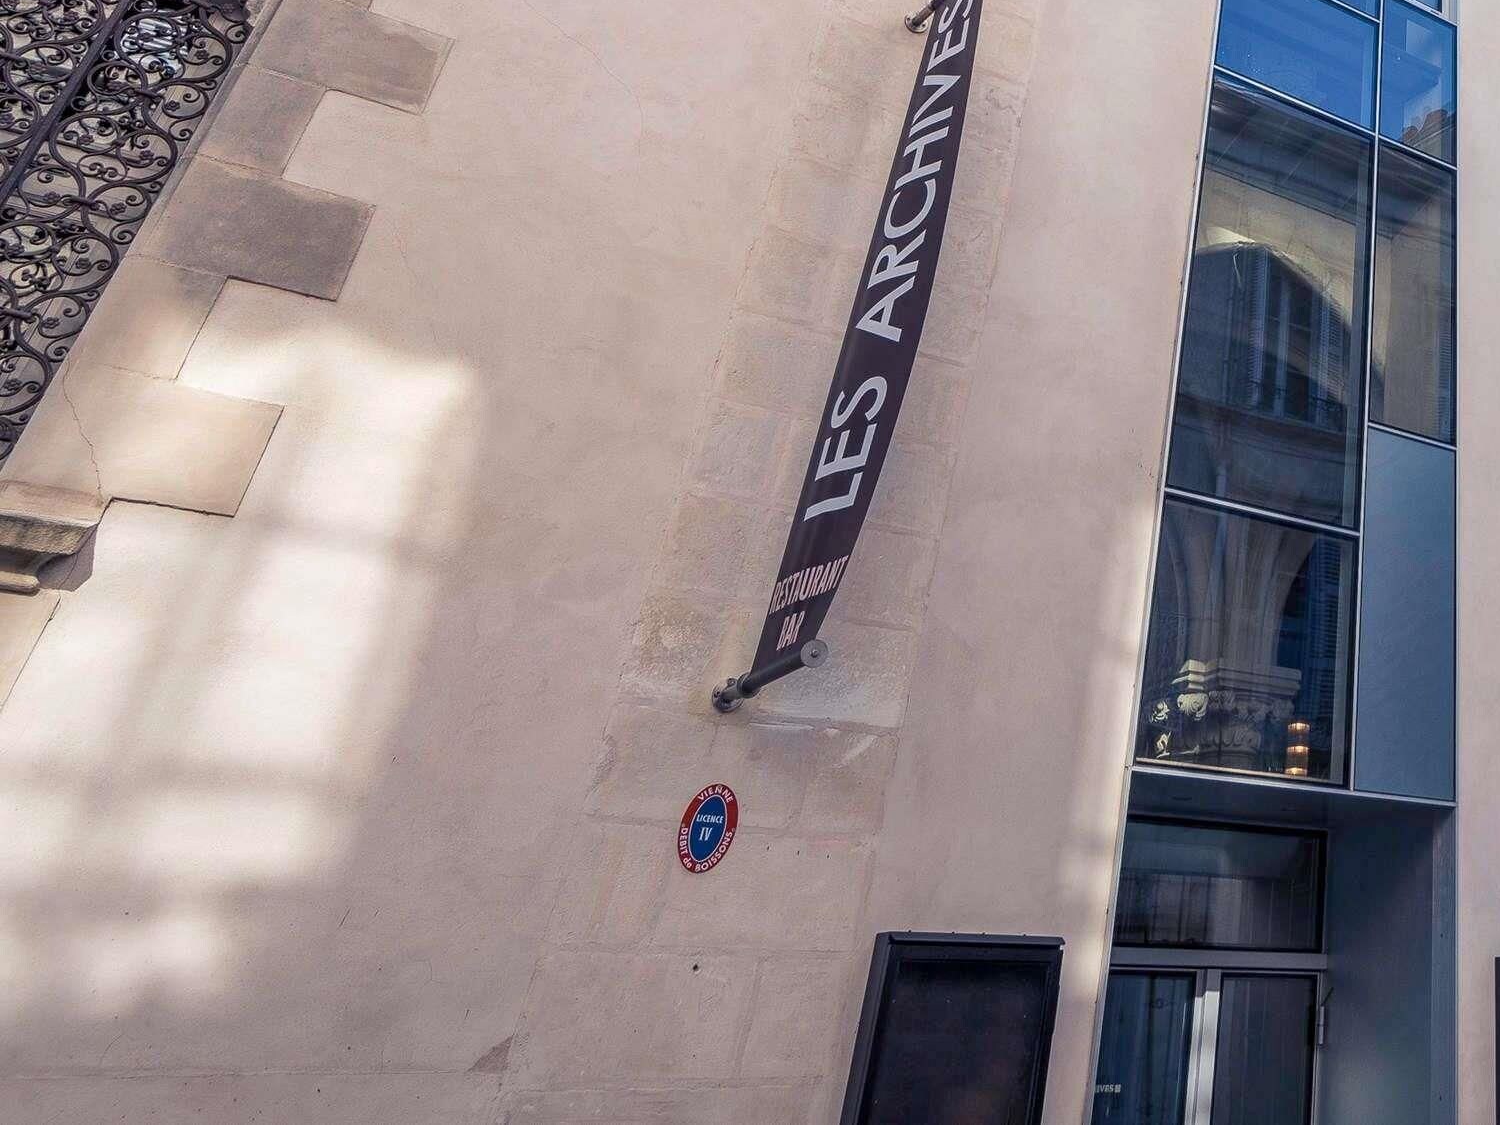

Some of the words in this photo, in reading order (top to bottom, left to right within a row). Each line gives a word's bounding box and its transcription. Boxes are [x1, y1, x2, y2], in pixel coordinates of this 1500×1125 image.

[804, 375, 888, 522] LES
[769, 555, 849, 615] RESTAURANT
[776, 610, 805, 651] BAR
[697, 785, 734, 803] VIENNE
[696, 814, 724, 824] LICENCE
[680, 827, 689, 855] DEBIT
[698, 827, 713, 841] IV
[683, 857, 693, 868] de
[695, 831, 733, 873] BOISSONS
